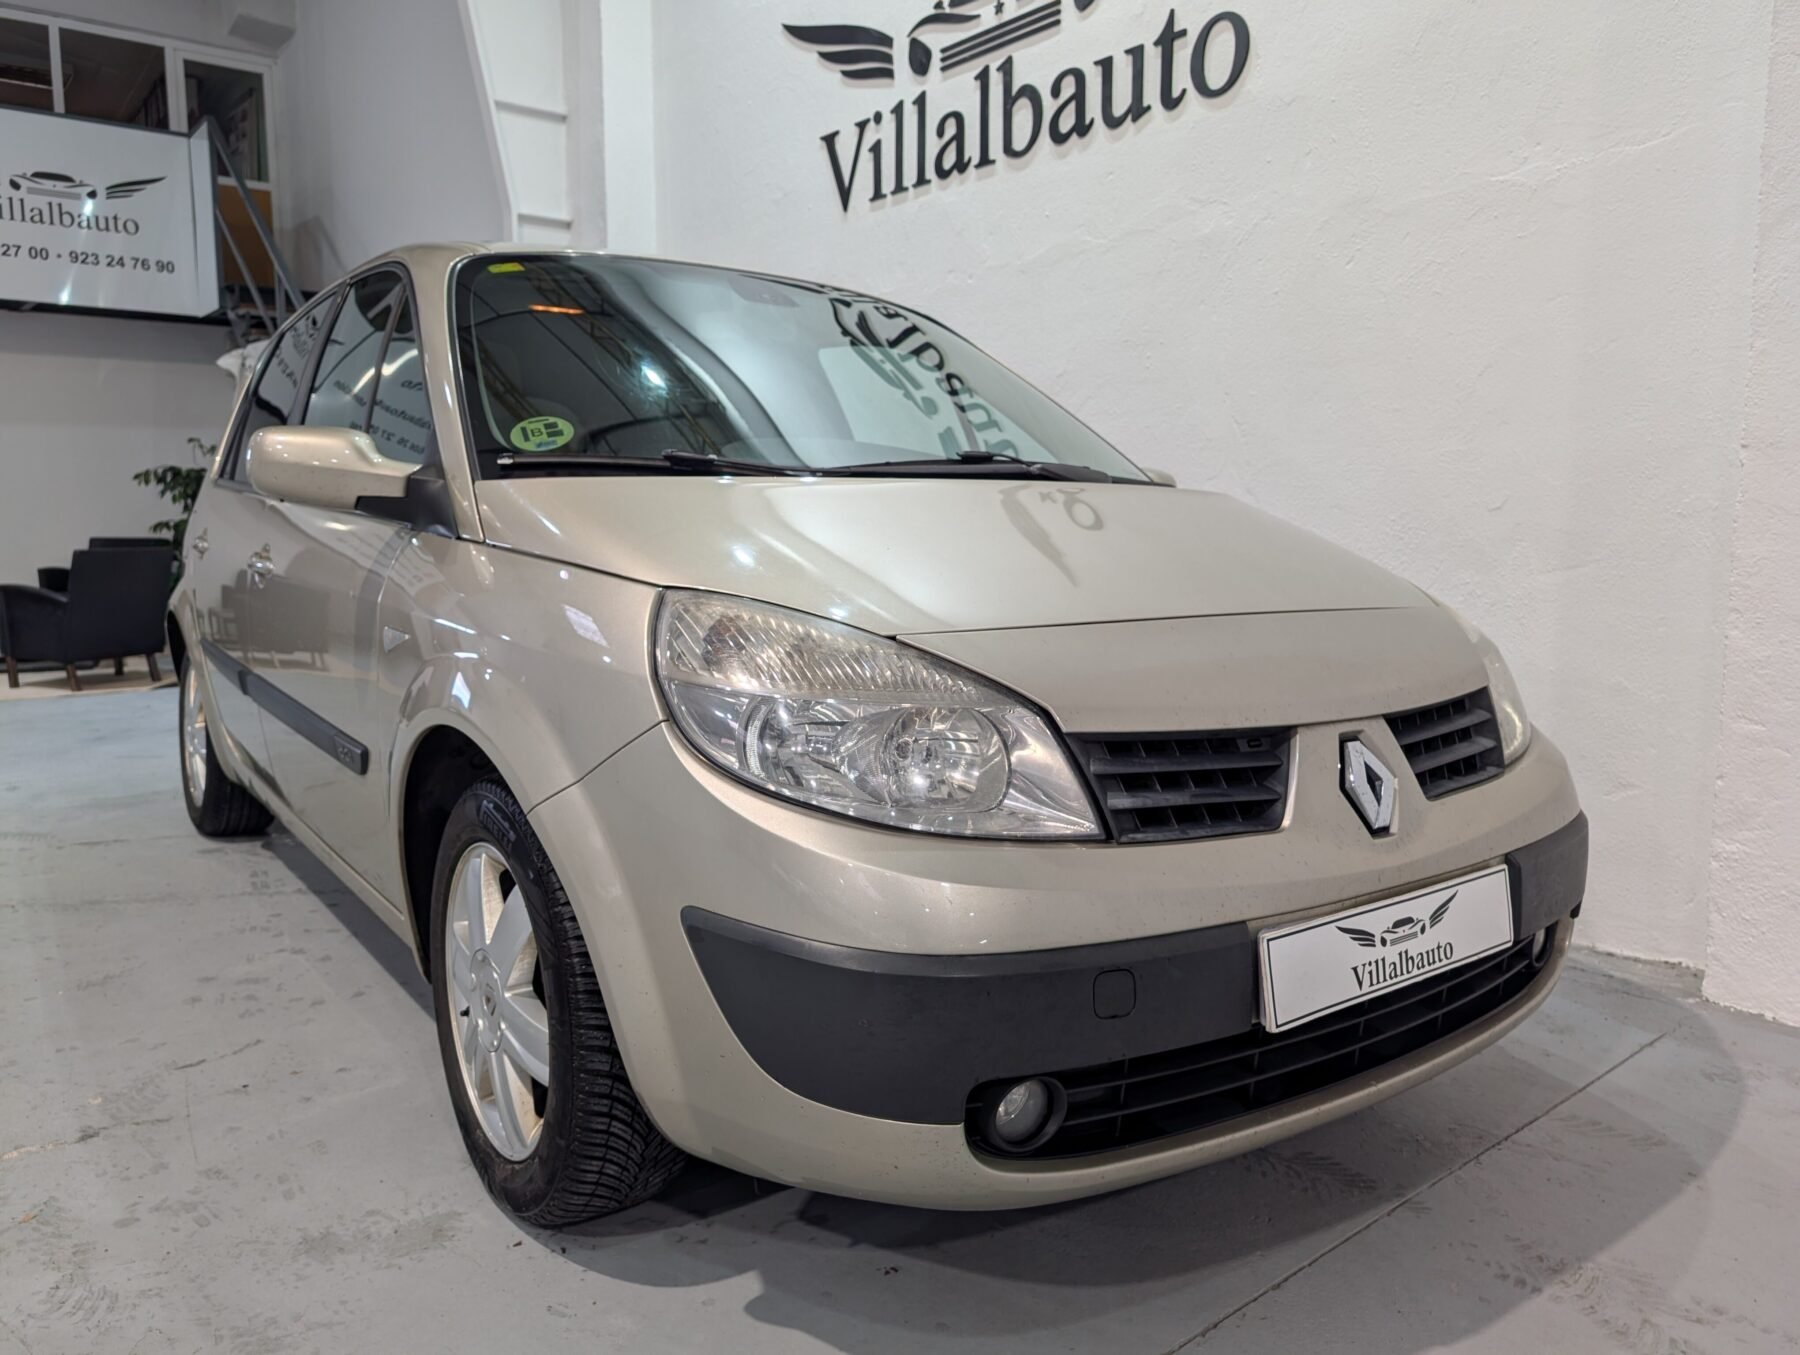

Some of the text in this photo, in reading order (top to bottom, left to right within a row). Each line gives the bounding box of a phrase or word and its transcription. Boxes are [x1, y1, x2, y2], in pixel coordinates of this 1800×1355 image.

[819, 8, 1250, 213] Villalbauto
[0, 195, 140, 235] illalbauto
[1, 243, 175, 274] 27 00 923 24 76 90
[530, 427, 544, 438] B
[1351, 941, 1454, 991] Villalbauto
